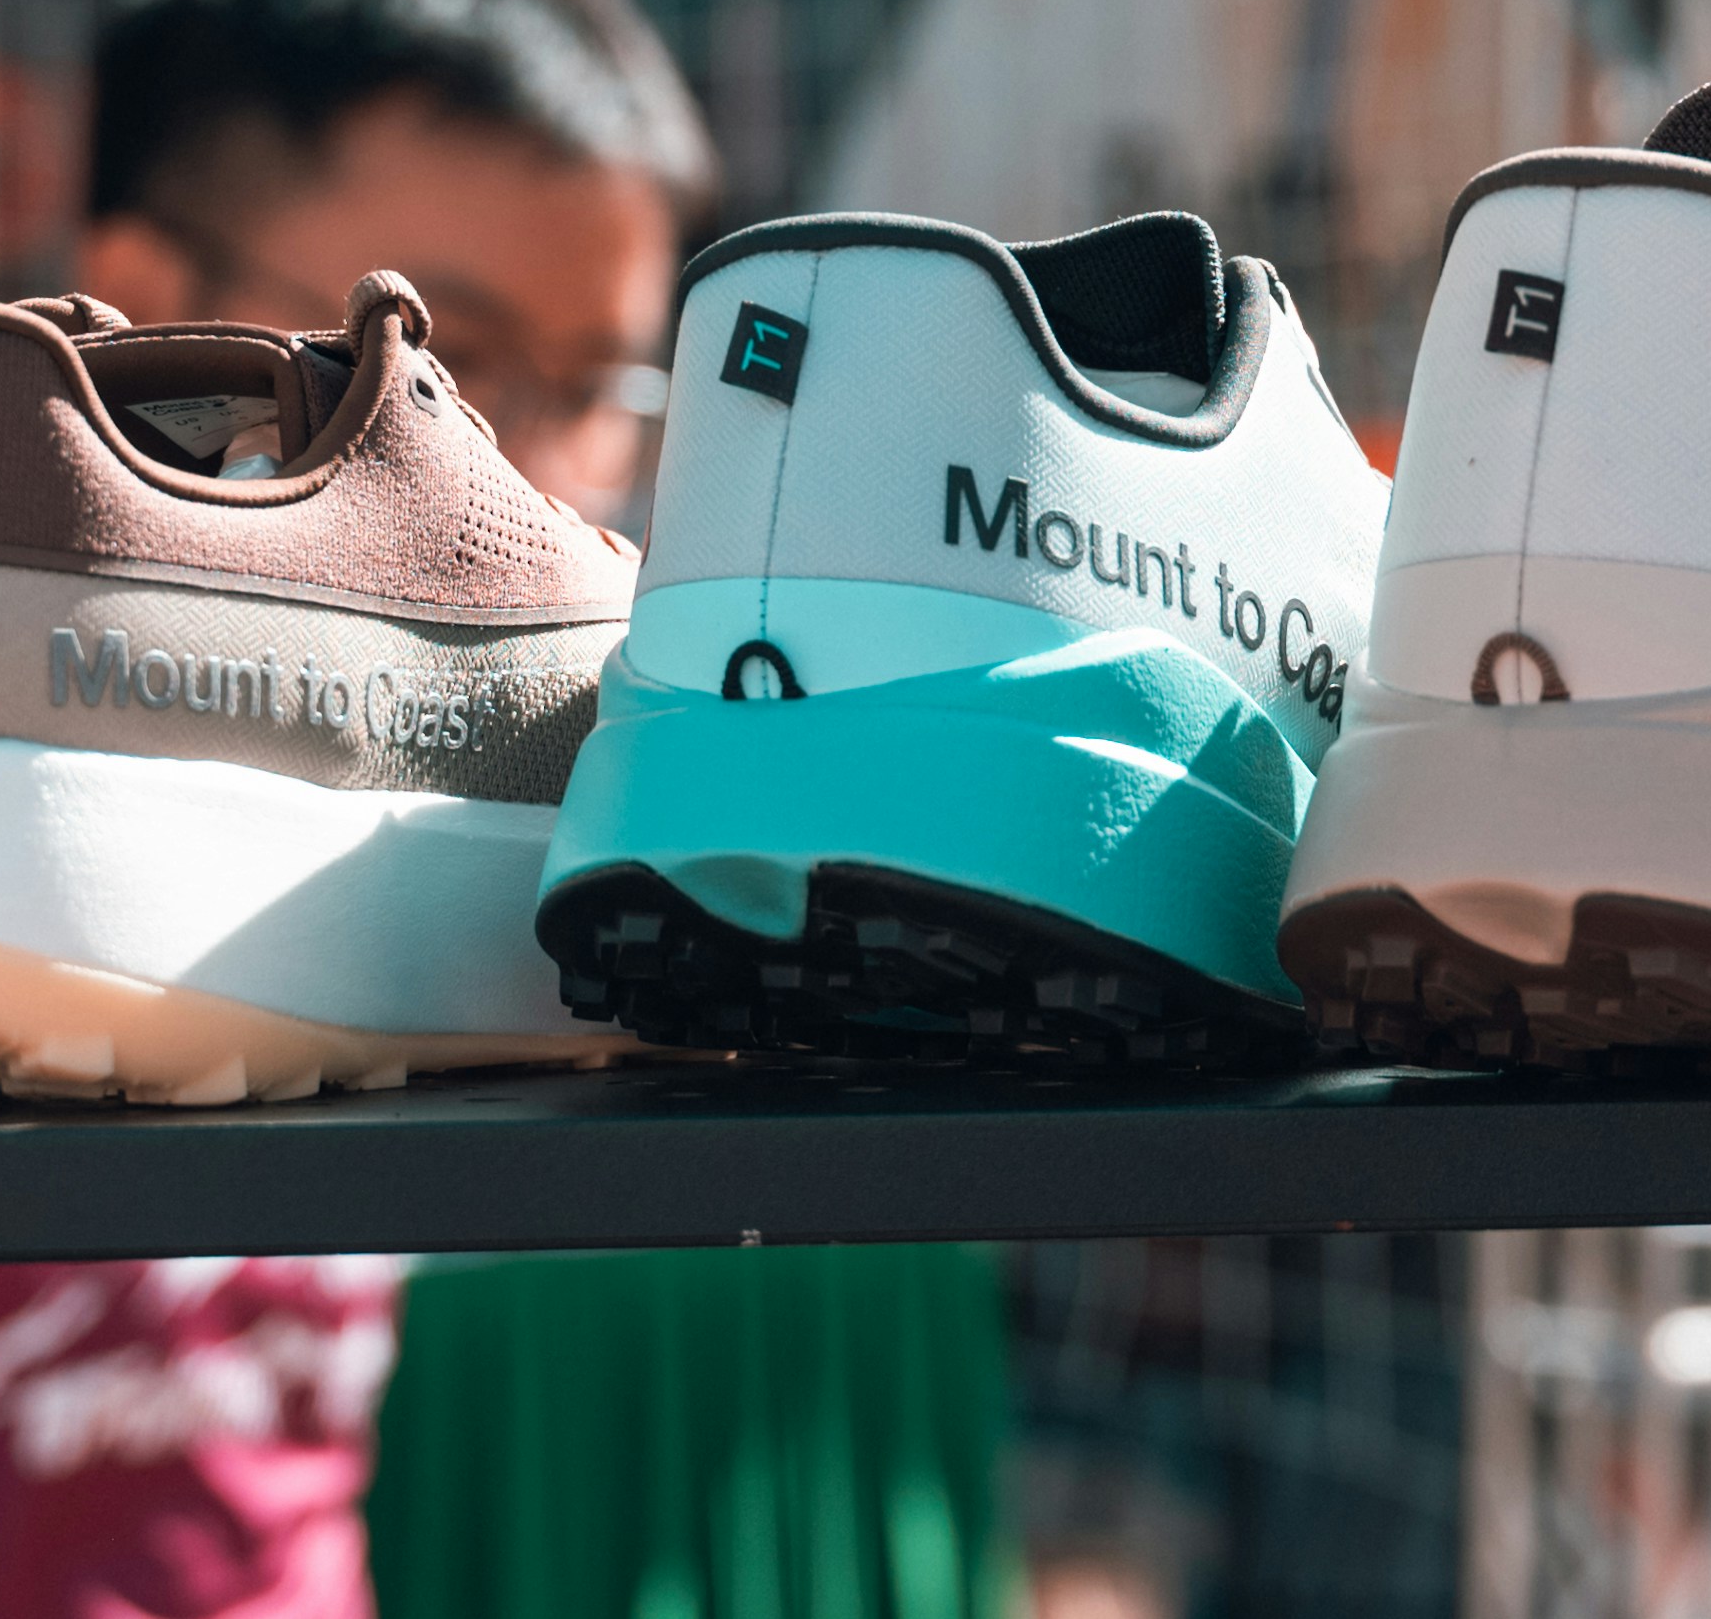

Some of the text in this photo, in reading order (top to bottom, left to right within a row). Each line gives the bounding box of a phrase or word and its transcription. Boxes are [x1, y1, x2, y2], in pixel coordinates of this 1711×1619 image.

[741, 320, 789, 371] T1
[1505, 285, 1554, 337] T1
[944, 464, 1349, 734] Mount to Coa
[50, 628, 496, 751] Mount to Coast
